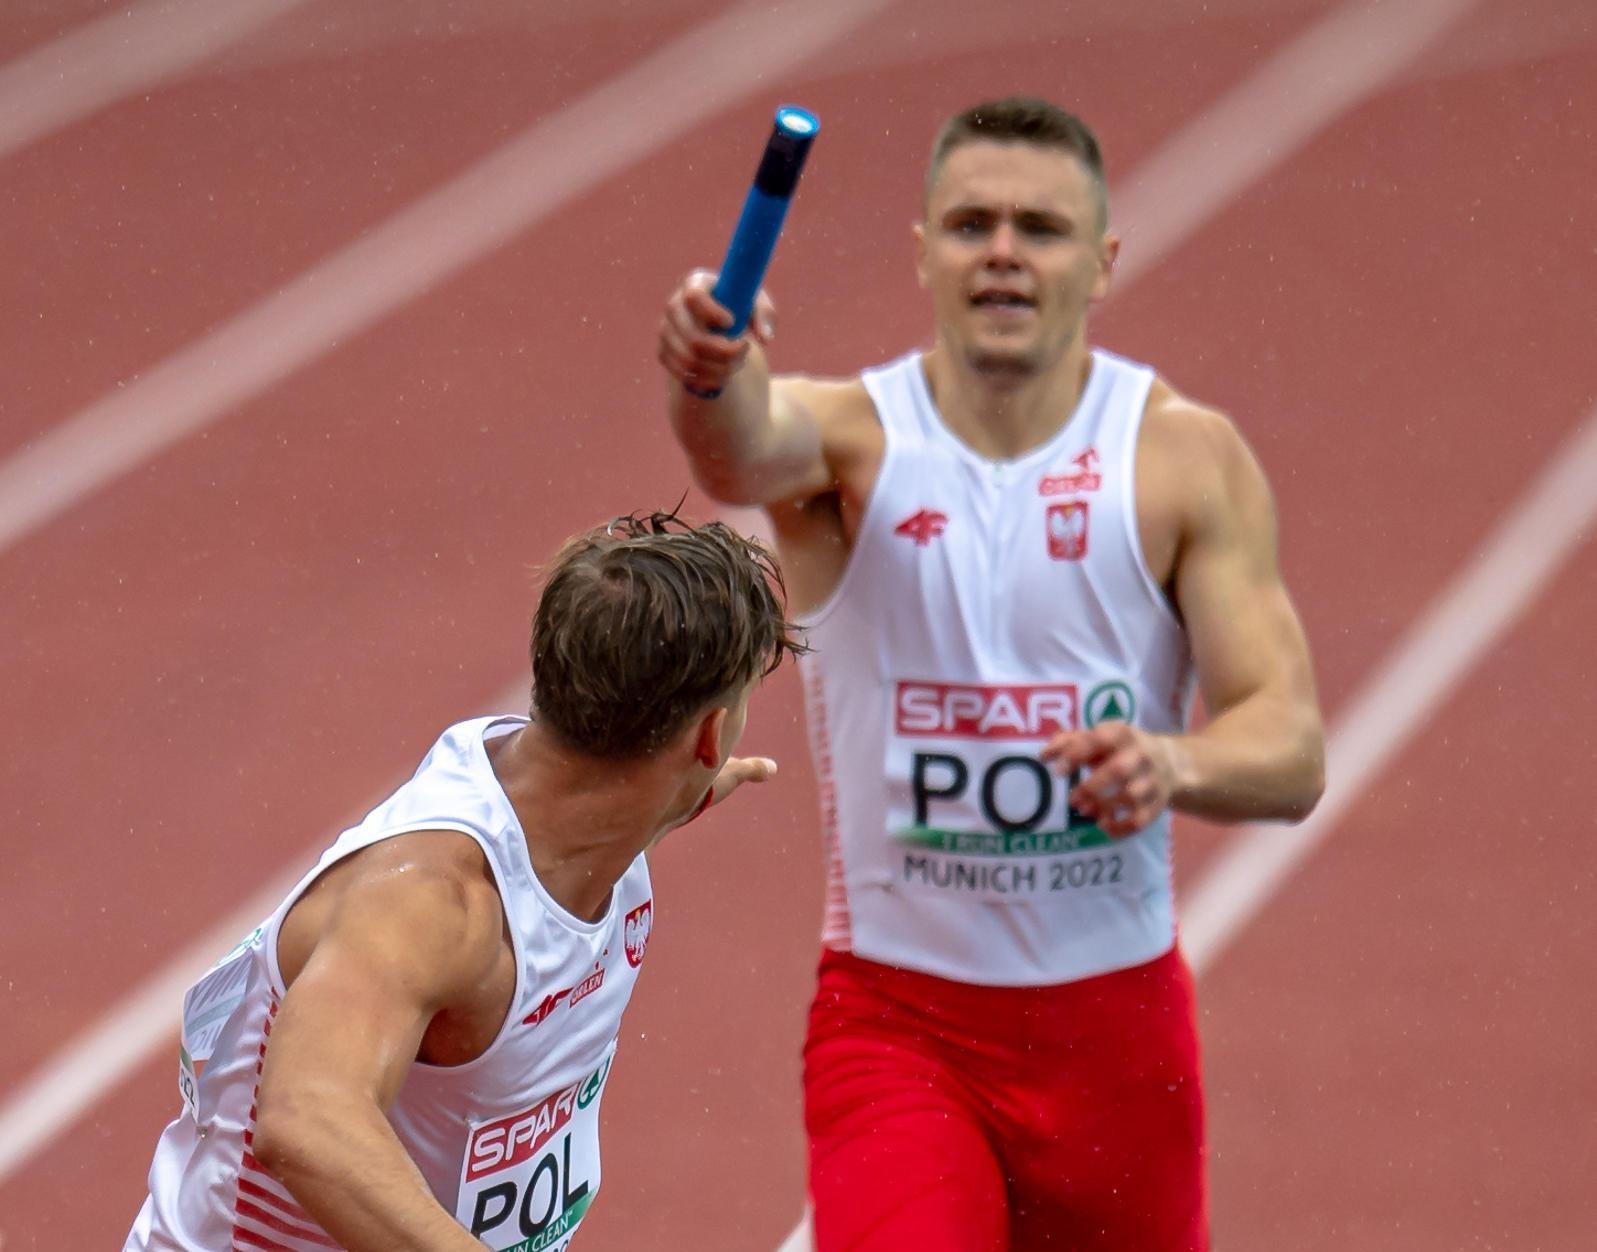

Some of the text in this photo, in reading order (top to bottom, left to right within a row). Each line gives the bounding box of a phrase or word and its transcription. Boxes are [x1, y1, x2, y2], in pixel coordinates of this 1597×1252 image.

[901, 687, 1074, 735] SPAR
[903, 854, 1124, 893] MUNICH 2022
[471, 1081, 579, 1172] SPAR
[470, 1131, 589, 1239] POL
